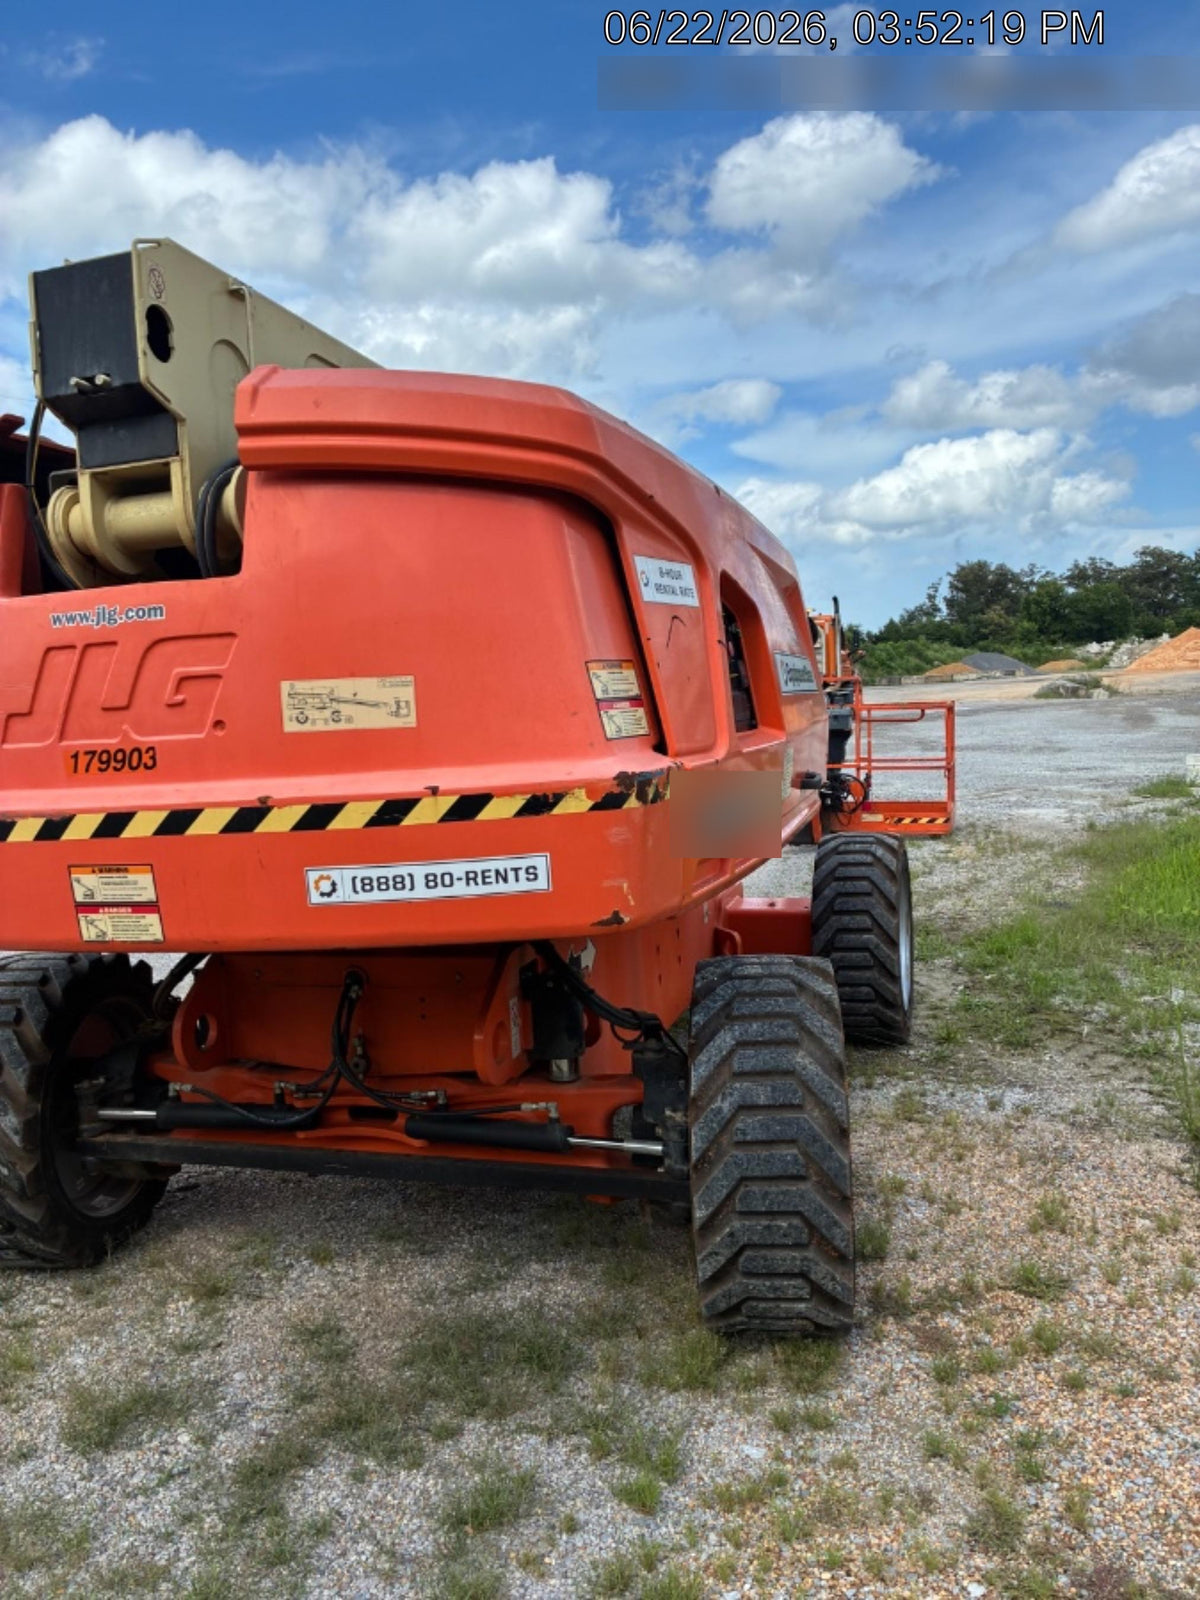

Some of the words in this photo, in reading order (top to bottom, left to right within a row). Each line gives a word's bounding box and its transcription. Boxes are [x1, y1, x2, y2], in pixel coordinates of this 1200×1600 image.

[659, 567, 683, 580] 8-HOUR
[654, 583, 679, 597] RENTAL
[679, 587, 695, 598] RATE
[51, 604, 164, 627] www.jlg.com
[1, 631, 238, 749] JLG
[70, 746, 157, 774] 179903
[351, 872, 415, 895] (888)
[424, 865, 539, 890] 80-RENTS
